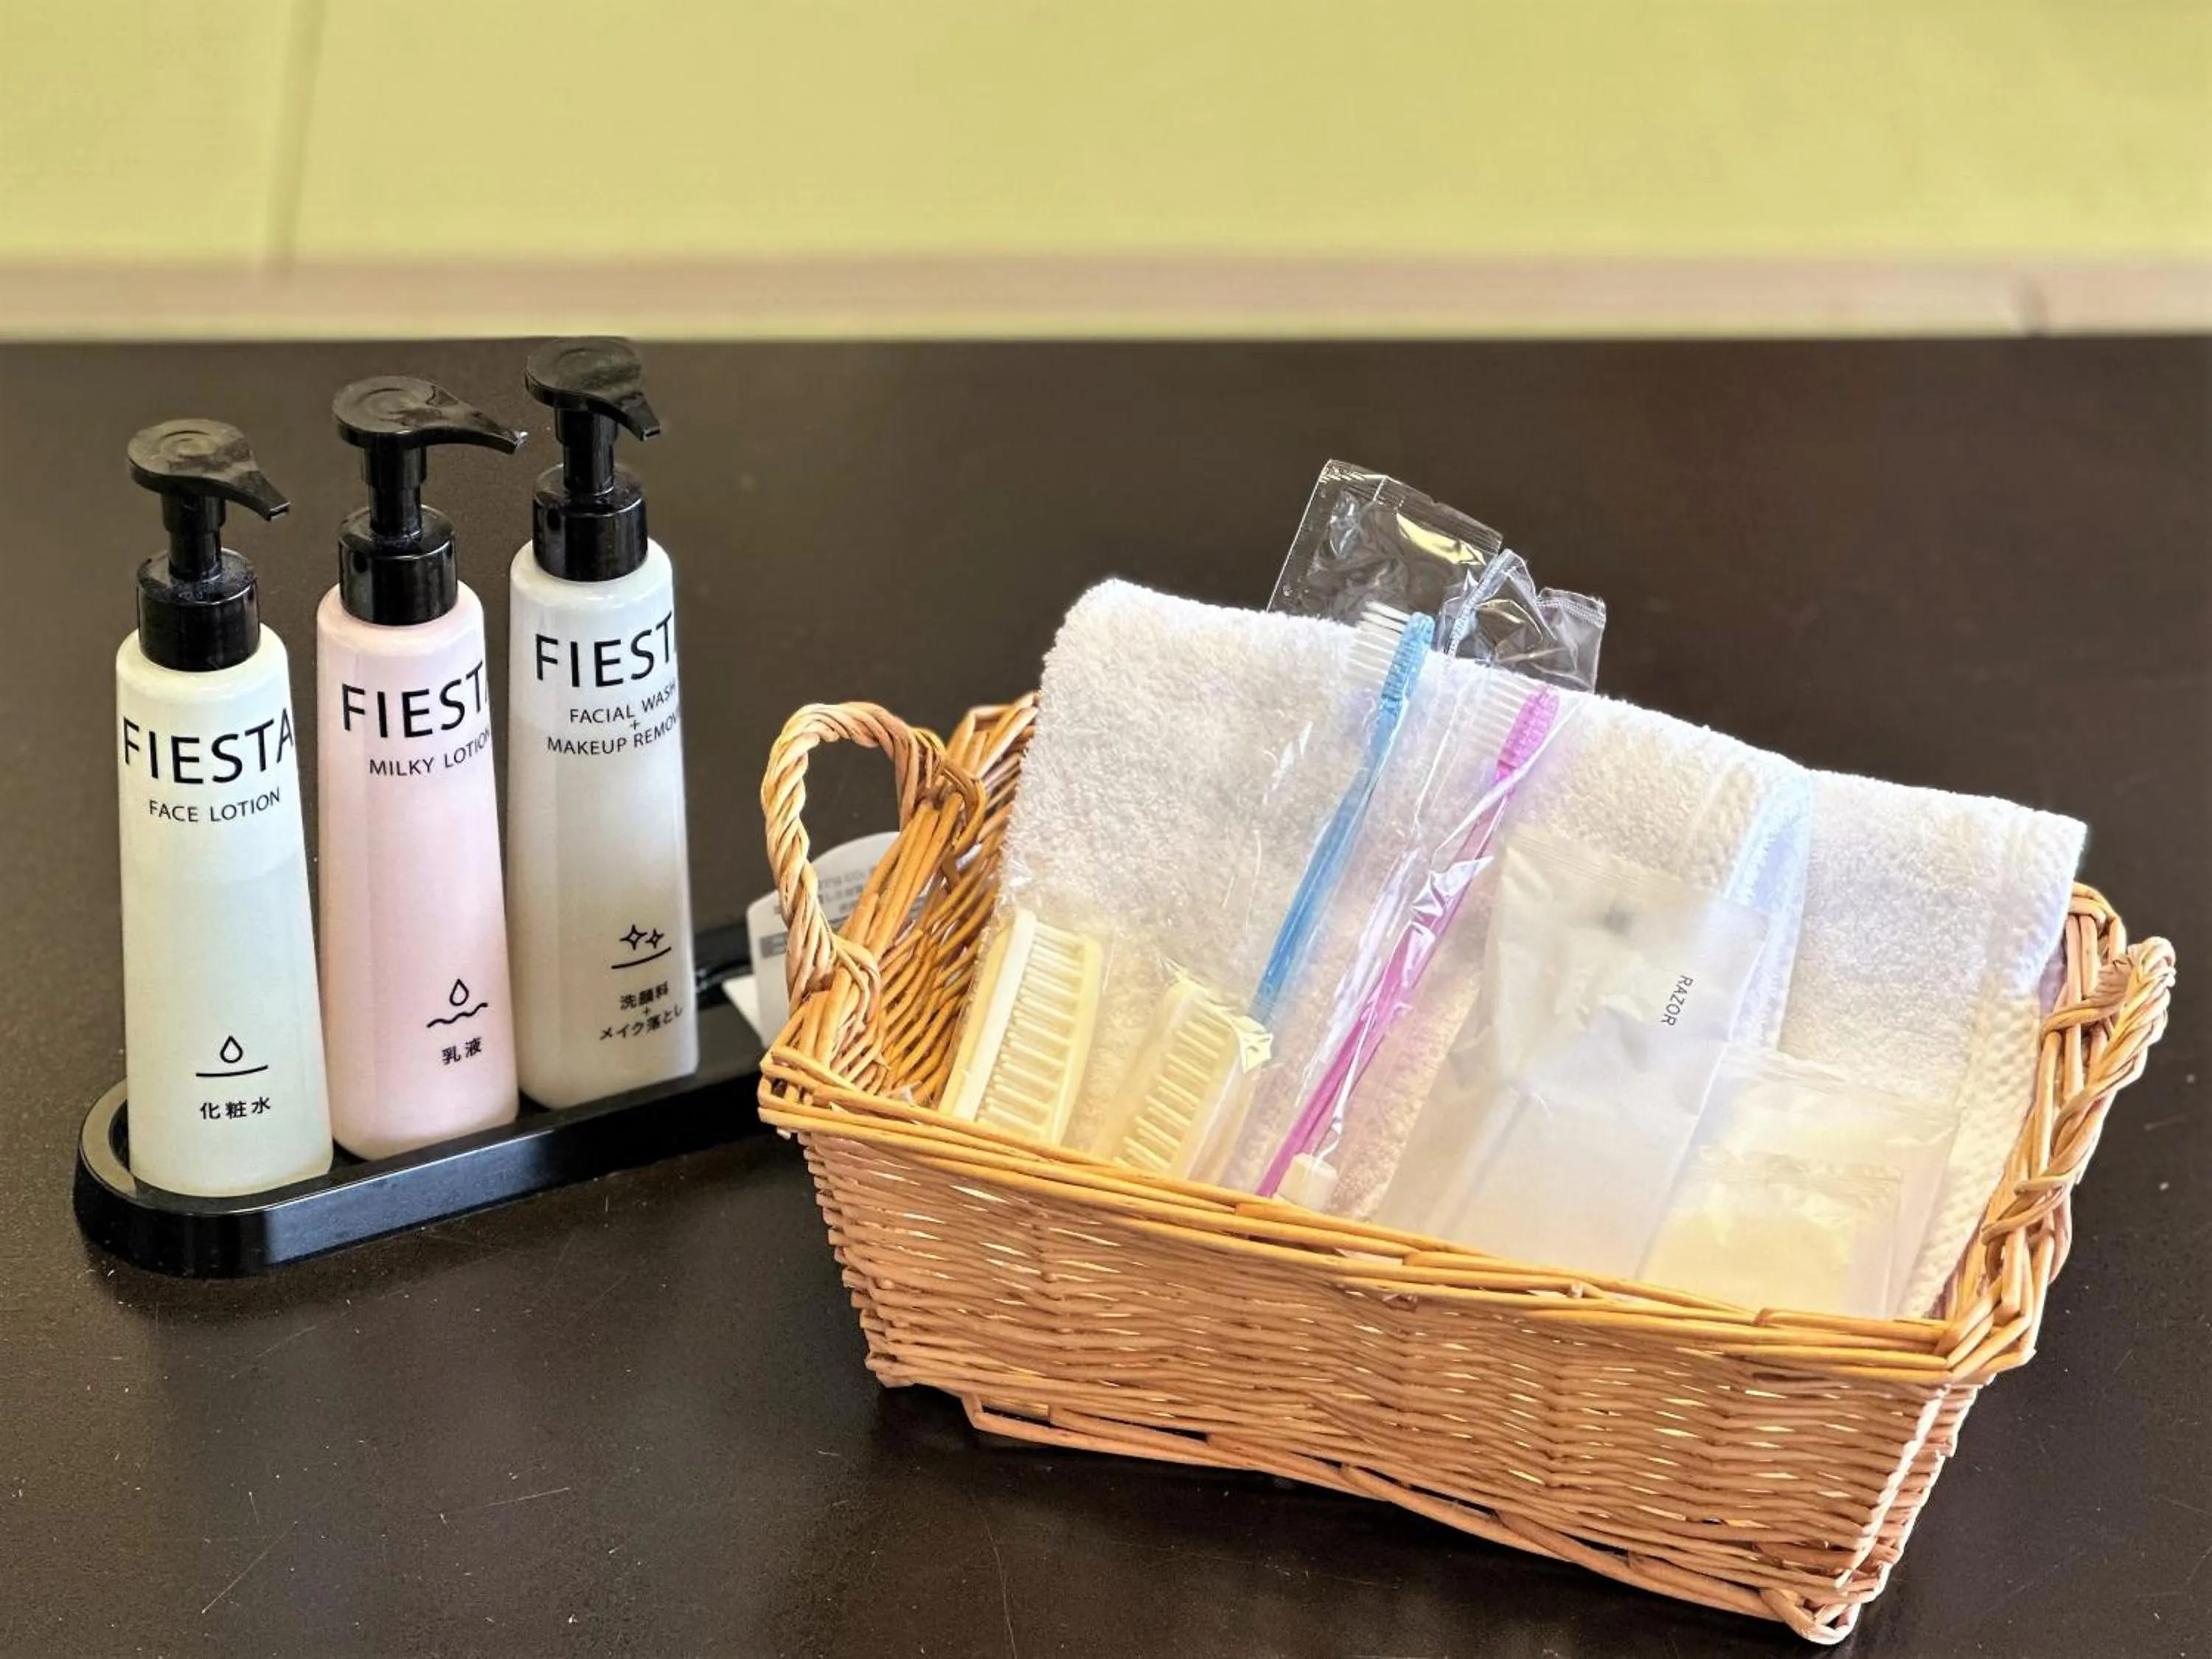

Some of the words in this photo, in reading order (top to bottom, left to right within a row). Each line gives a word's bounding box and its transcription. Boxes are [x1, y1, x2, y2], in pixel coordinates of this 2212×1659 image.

[341, 660, 488, 738] FIEST
[569, 705, 635, 723] FACIAL
[641, 678, 676, 713] WASH
[123, 707, 294, 785] FIESTA
[547, 737, 627, 755] MAKEUP
[369, 757, 434, 776] MILKY
[149, 799, 198, 822] FACE
[210, 786, 280, 822] LOTION
[620, 981, 669, 1010] 洗顔料
[1660, 975, 1694, 1026] RAZOR
[599, 1004, 683, 1040] メイク落とし
[442, 1037, 482, 1065] 乳液
[200, 1096, 271, 1120] 化粧水
